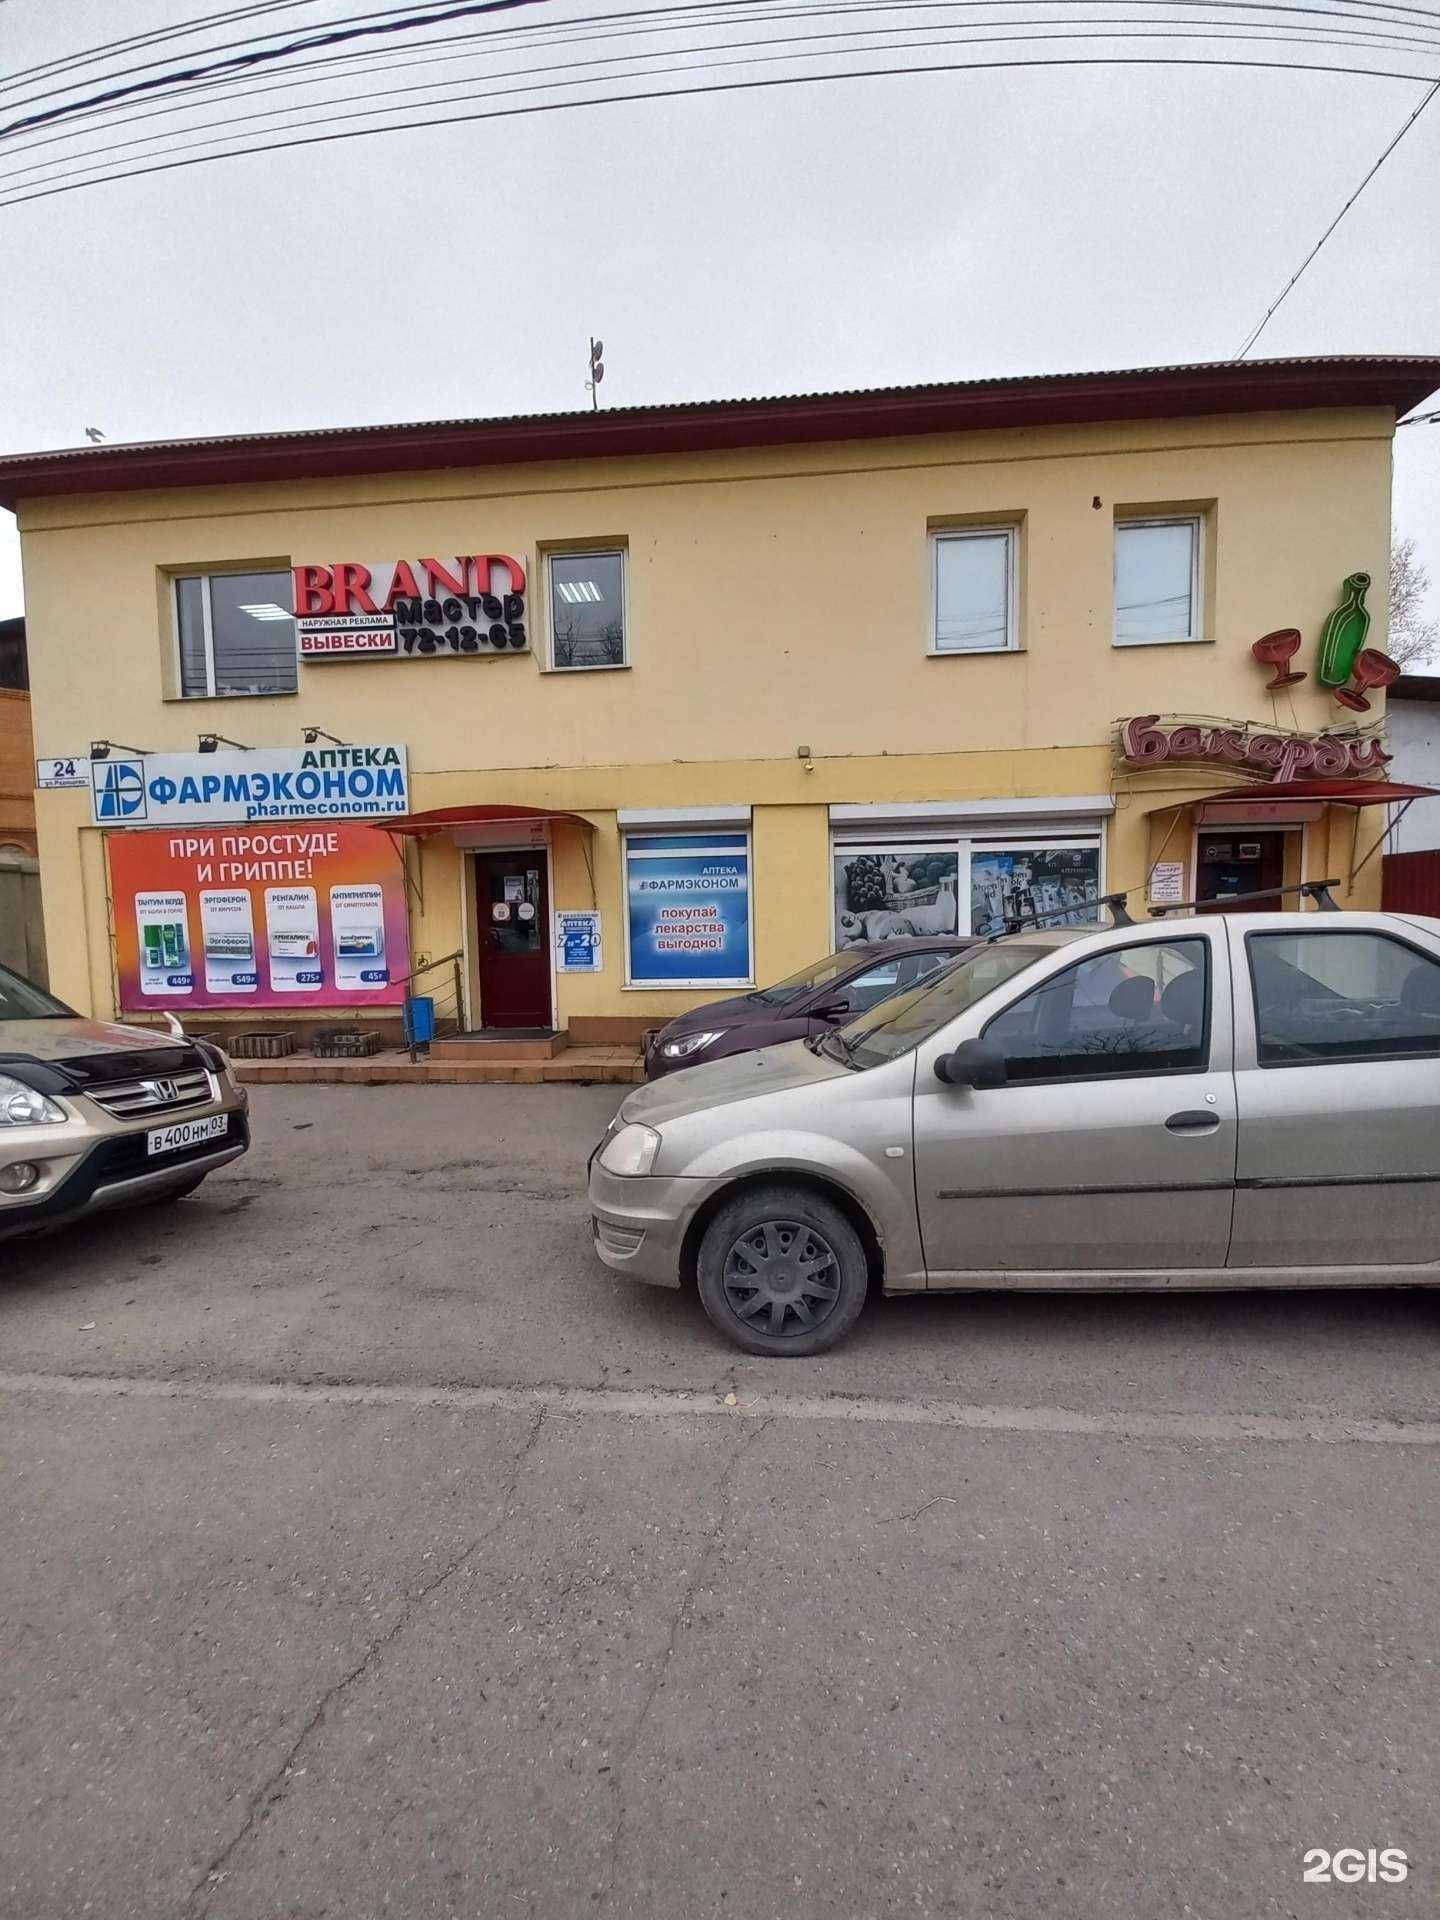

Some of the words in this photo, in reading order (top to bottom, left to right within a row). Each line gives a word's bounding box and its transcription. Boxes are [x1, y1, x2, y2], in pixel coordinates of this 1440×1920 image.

[292, 554, 527, 618] BRAND
[302, 618, 348, 627] НАРУЖНАЯ
[349, 616, 388, 625] РЕКЛАМА
[301, 633, 392, 651] ВЫВЕСКИ
[400, 622, 526, 654] 72-12-65
[301, 747, 400, 769] АПТЕКА
[54, 761, 76, 777] 24
[149, 768, 405, 805] ФАРМЭКОНОМ
[246, 799, 406, 819] pharmeconom.ru
[169, 838, 215, 858] ПРИ
[222, 833, 339, 857] ПРОСТУДЕ
[197, 863, 213, 882] И
[219, 859, 313, 882] ГРИППЕ!
[702, 867, 738, 875] АПТЕКА
[649, 878, 739, 890] ФАРМЭКОНОМ
[272, 894, 309, 902] РЕНГАЛИН
[661, 906, 717, 921] покупай
[655, 923, 725, 935] лекарства
[154, 1124, 208, 1150] В400НМ
[211, 1117, 224, 1129] 03
